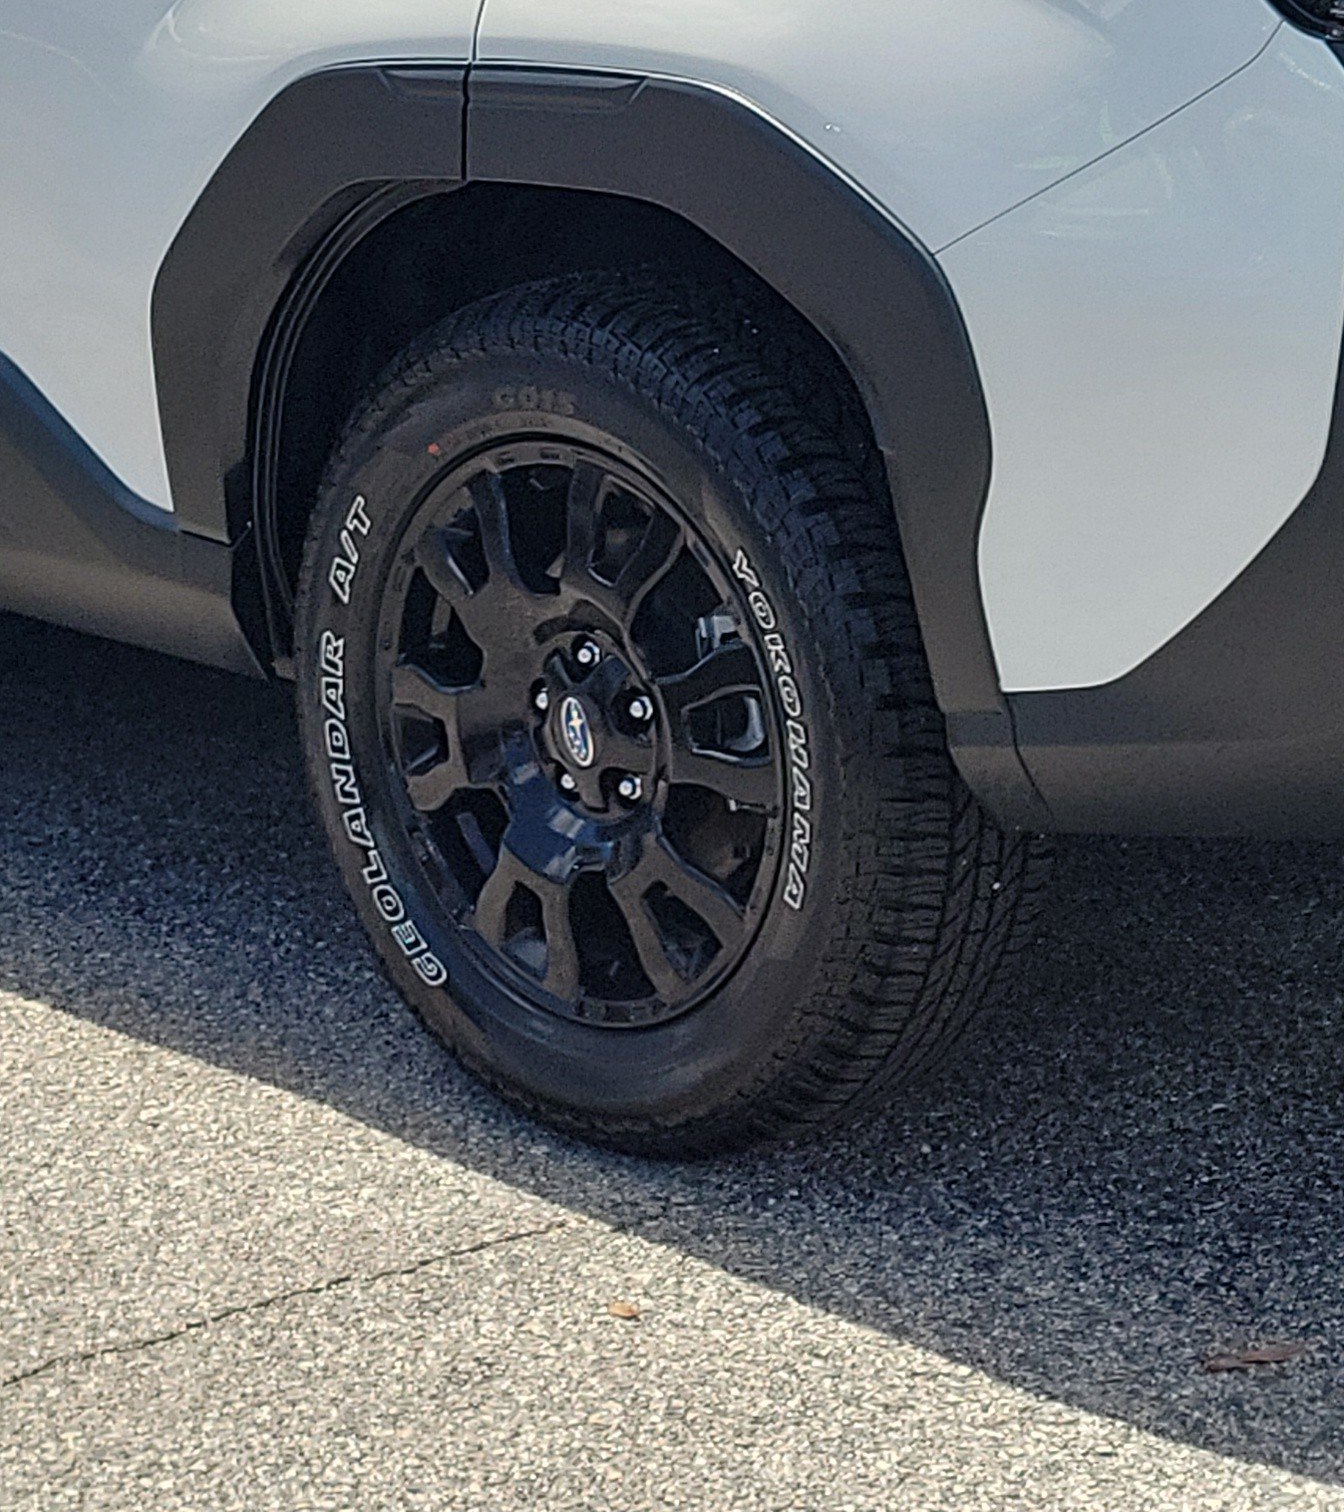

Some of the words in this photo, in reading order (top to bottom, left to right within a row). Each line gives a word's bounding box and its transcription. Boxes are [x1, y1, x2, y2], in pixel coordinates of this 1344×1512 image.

[329, 496, 372, 605] A/T
[321, 630, 448, 986] GEOLANDAR
[732, 548, 811, 910] YOKOHAMA
